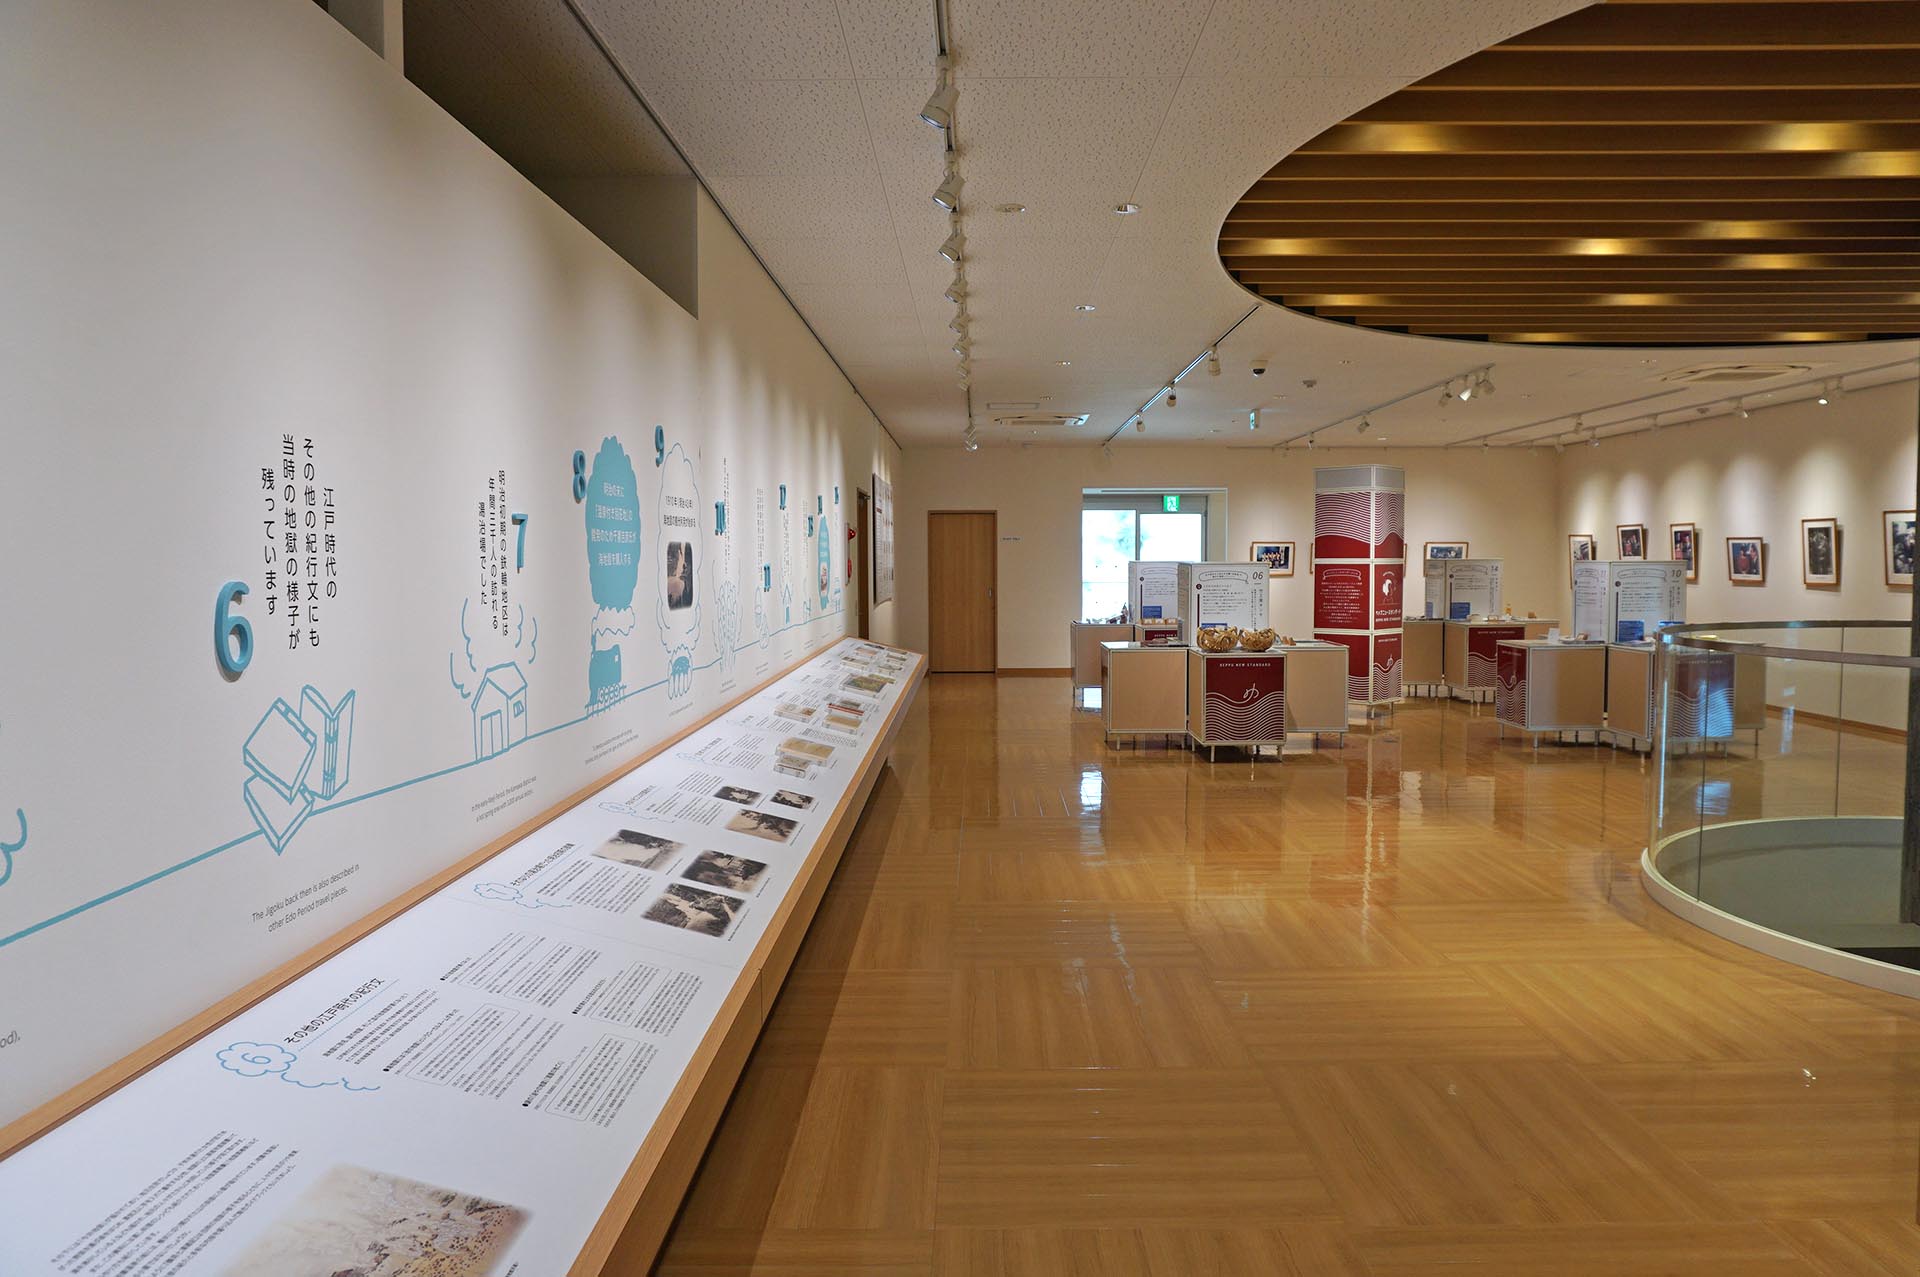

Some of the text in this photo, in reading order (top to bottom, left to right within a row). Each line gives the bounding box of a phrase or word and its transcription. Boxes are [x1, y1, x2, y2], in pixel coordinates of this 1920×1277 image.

[655, 425, 664, 465] 9
[573, 450, 586, 501] 8
[261, 467, 278, 616] 残っています
[282, 434, 301, 650] 当時の地獄の様子が
[303, 438, 320, 648] その他の紀行文にも
[323, 487, 338, 599] 江戸時代の
[512, 513, 528, 568] 7
[1252, 571, 1264, 580] 06
[1672, 569, 1682, 578] 10
[214, 580, 254, 673] 6
[318, 879, 330, 890] also
[268, 918, 285, 934] other
